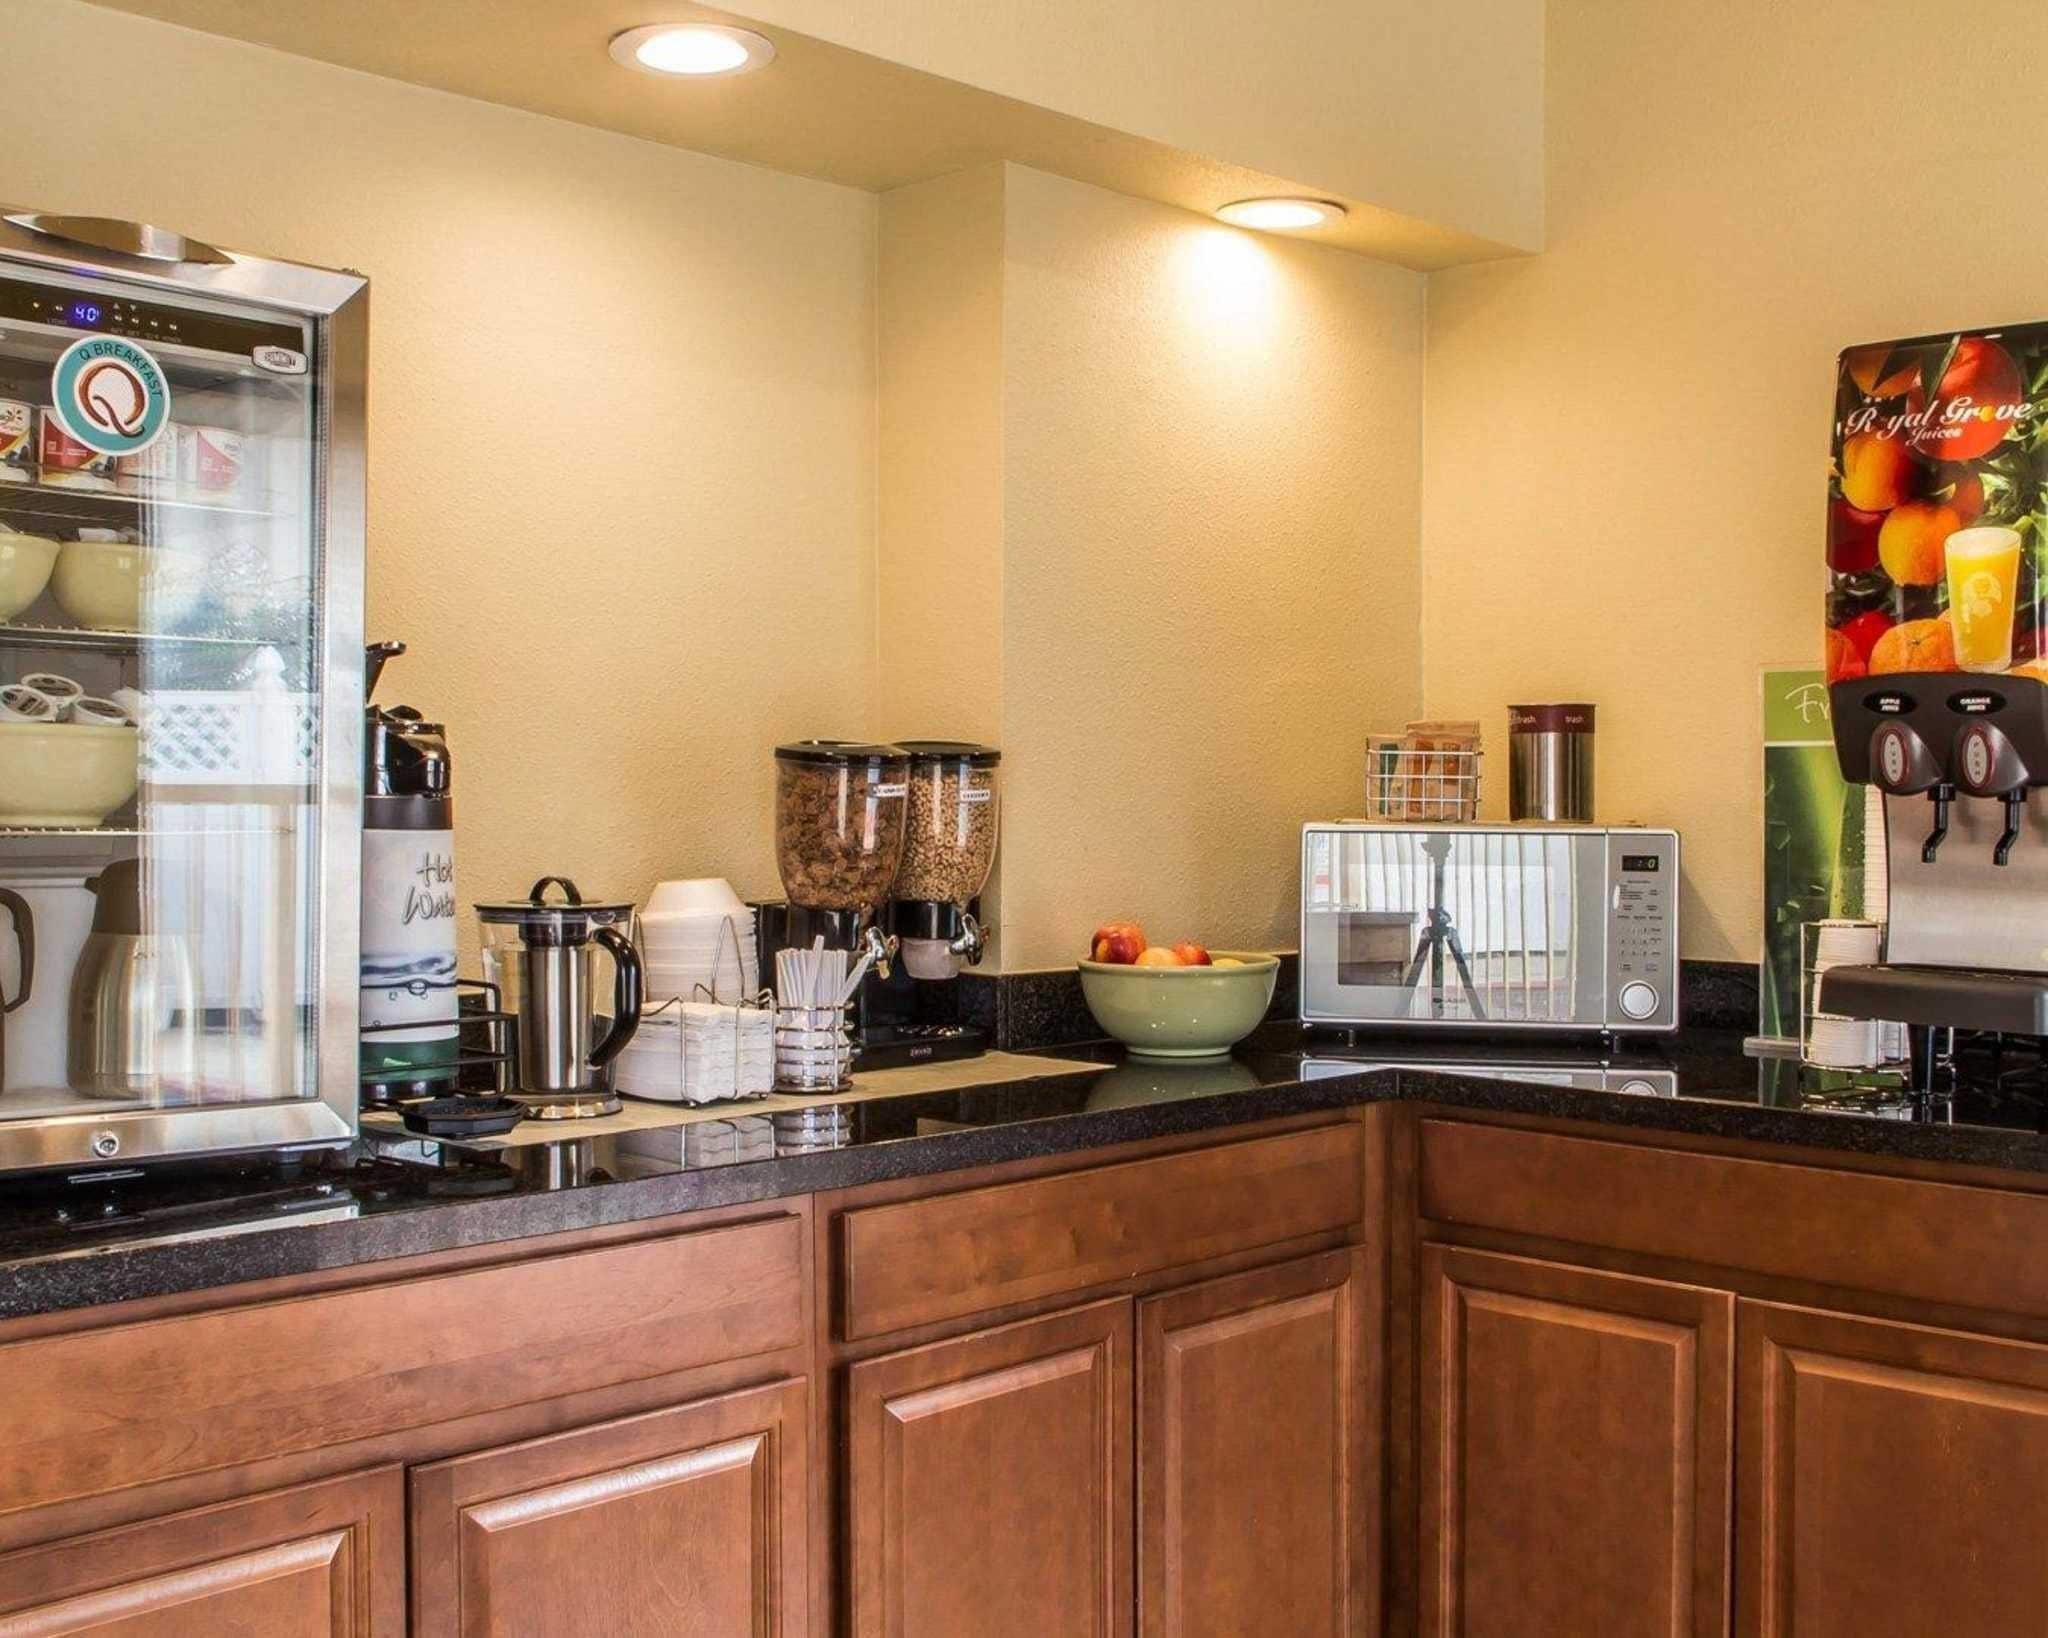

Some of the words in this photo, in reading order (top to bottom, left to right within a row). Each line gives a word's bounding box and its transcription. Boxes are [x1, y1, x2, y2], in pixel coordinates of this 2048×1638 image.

[93, 342, 163, 397] BREAKFAST
[1843, 399, 1939, 441] Ryal
[402, 885, 455, 926] Wate
